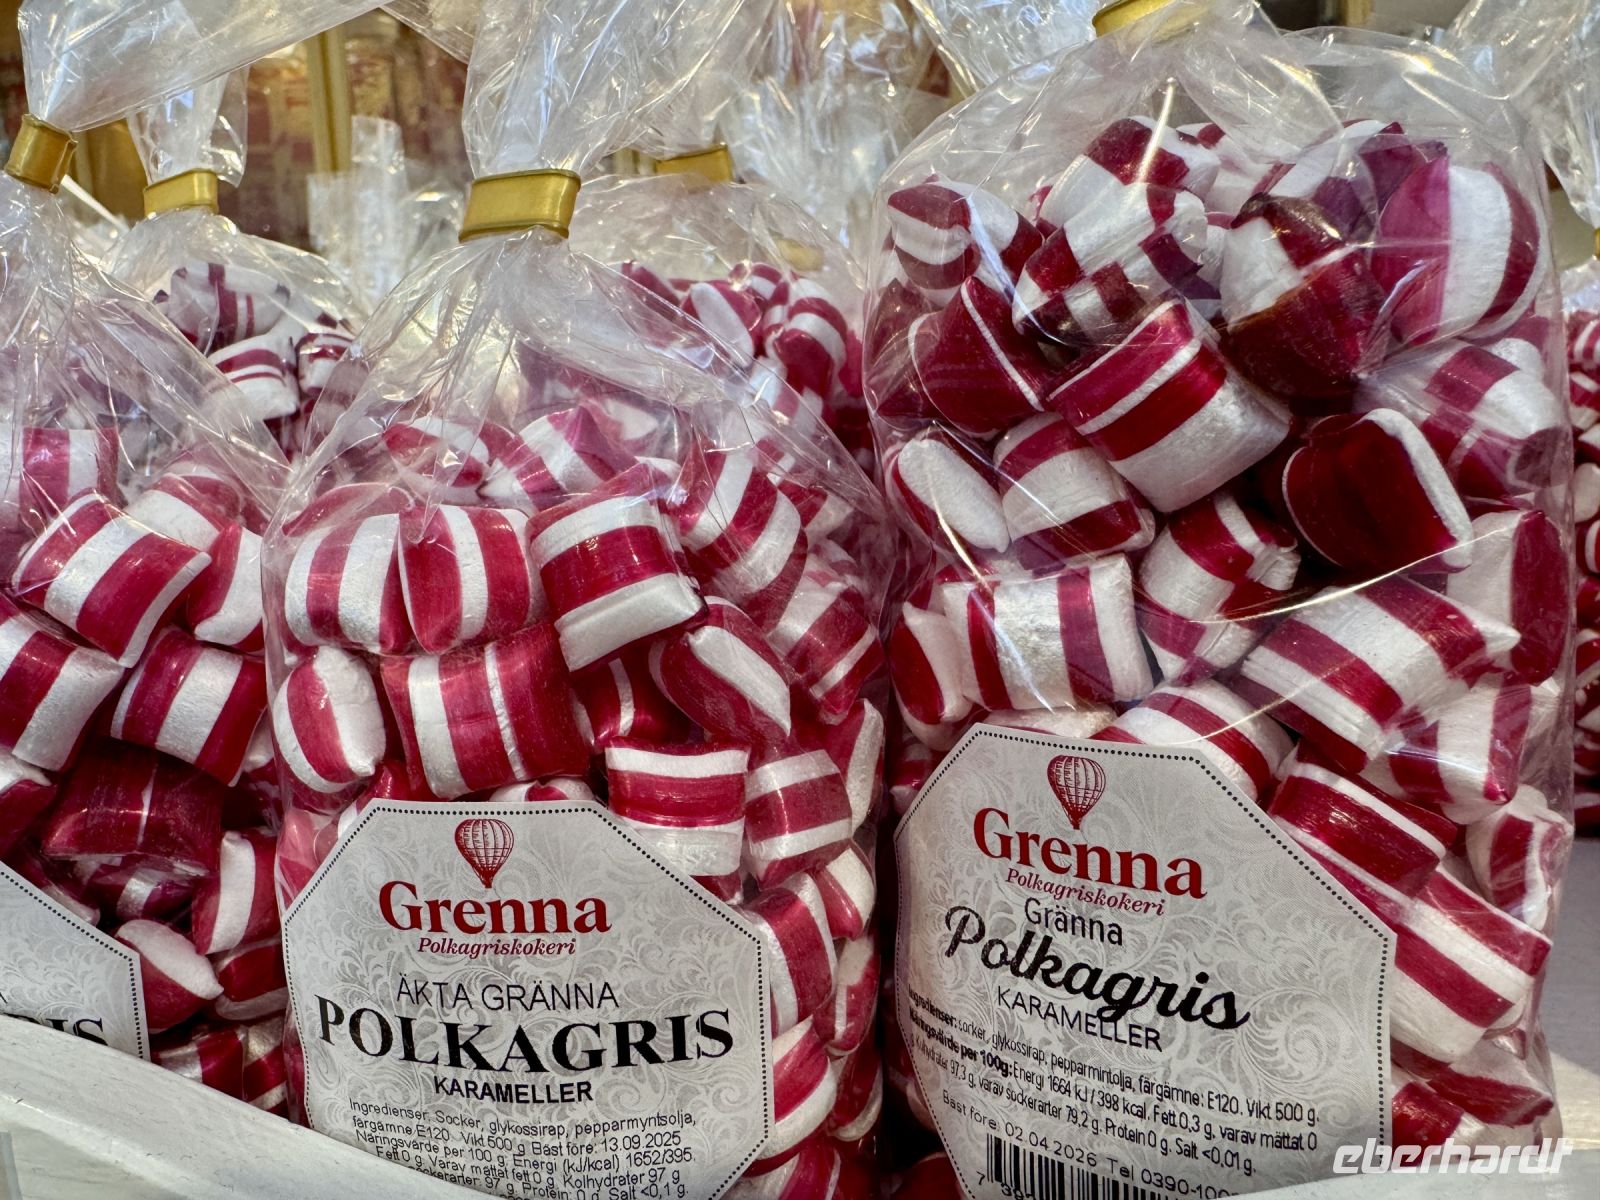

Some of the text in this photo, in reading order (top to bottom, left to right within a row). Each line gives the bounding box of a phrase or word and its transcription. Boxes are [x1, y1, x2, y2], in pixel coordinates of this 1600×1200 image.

[973, 807, 1208, 899] Grenna
[379, 880, 612, 935] Grenna
[1005, 868, 1166, 916] Polkagriskokeri
[1024, 897, 1123, 946] Gränna
[418, 937, 577, 960] Polkagriskokeri
[945, 905, 1251, 1030] Polkagris
[397, 972, 619, 1012] ÄKTA GRÄNNA
[314, 994, 734, 1074] POLKAGRIS
[998, 985, 1162, 1053] KARAMELLER
[434, 1075, 594, 1104] KARAMELLER
[980, 1050, 1013, 1078] 100g:
[1013, 1061, 1045, 1092] Energi
[1047, 1074, 1071, 1098] 1664
[1075, 1084, 1088, 1103] kJ
[1097, 1090, 1120, 1112] 398
[1123, 1097, 1150, 1121] kcal.
[1153, 1104, 1177, 1128] Fett
[1219, 1125, 1257, 1145] varav
[1260, 1131, 1305, 1151] mättat
[1307, 1132, 1317, 1151] 0
[1051, 1052, 1135, 1093] pepparmintolja,
[1138, 1075, 1204, 1108] färgämne:
[1207, 1091, 1243, 1116] E120.
[1246, 1098, 1272, 1120] Vikt
[1275, 1102, 1303, 1122] 500
[1307, 1108, 1320, 1128] g.
[435, 1110, 484, 1132] Socker,
[489, 1117, 570, 1139] glykossirap,
[575, 1110, 697, 1139] pepparmyntsolja,
[460, 1131, 485, 1148] Vikt
[487, 1136, 513, 1152] 500
[531, 1142, 563, 1157] Bäst
[566, 1142, 598, 1156] före:
[601, 1130, 682, 1153] 13.09.2025
[943, 1089, 967, 1116] Bäst
[1106, 1157, 1135, 1182] Tel
[979, 1078, 1004, 1097] varav
[1006, 1087, 1061, 1120] sockerarter
[1105, 1118, 1146, 1146] Protein
[1148, 1130, 1157, 1148] 0
[1175, 1137, 1199, 1161] Salt
[355, 1129, 440, 1154] Näringsvärde
[444, 1147, 465, 1159] per
[469, 1148, 493, 1163] 100
[513, 1153, 557, 1175] Energi
[563, 1154, 620, 1177] (kJ/kcal)
[626, 1147, 697, 1167] 1652/395.
[376, 1146, 400, 1162] Fett
[402, 1150, 411, 1163] 0
[428, 1154, 466, 1174] Varav
[471, 1164, 509, 1181] mättat
[511, 1168, 531, 1183] fett
[533, 1171, 542, 1185] 0
[563, 1171, 646, 1192] Kolhydrater
[648, 1166, 666, 1184] 97
[484, 1176, 501, 1190] 97
[976, 1171, 986, 1186] 7
